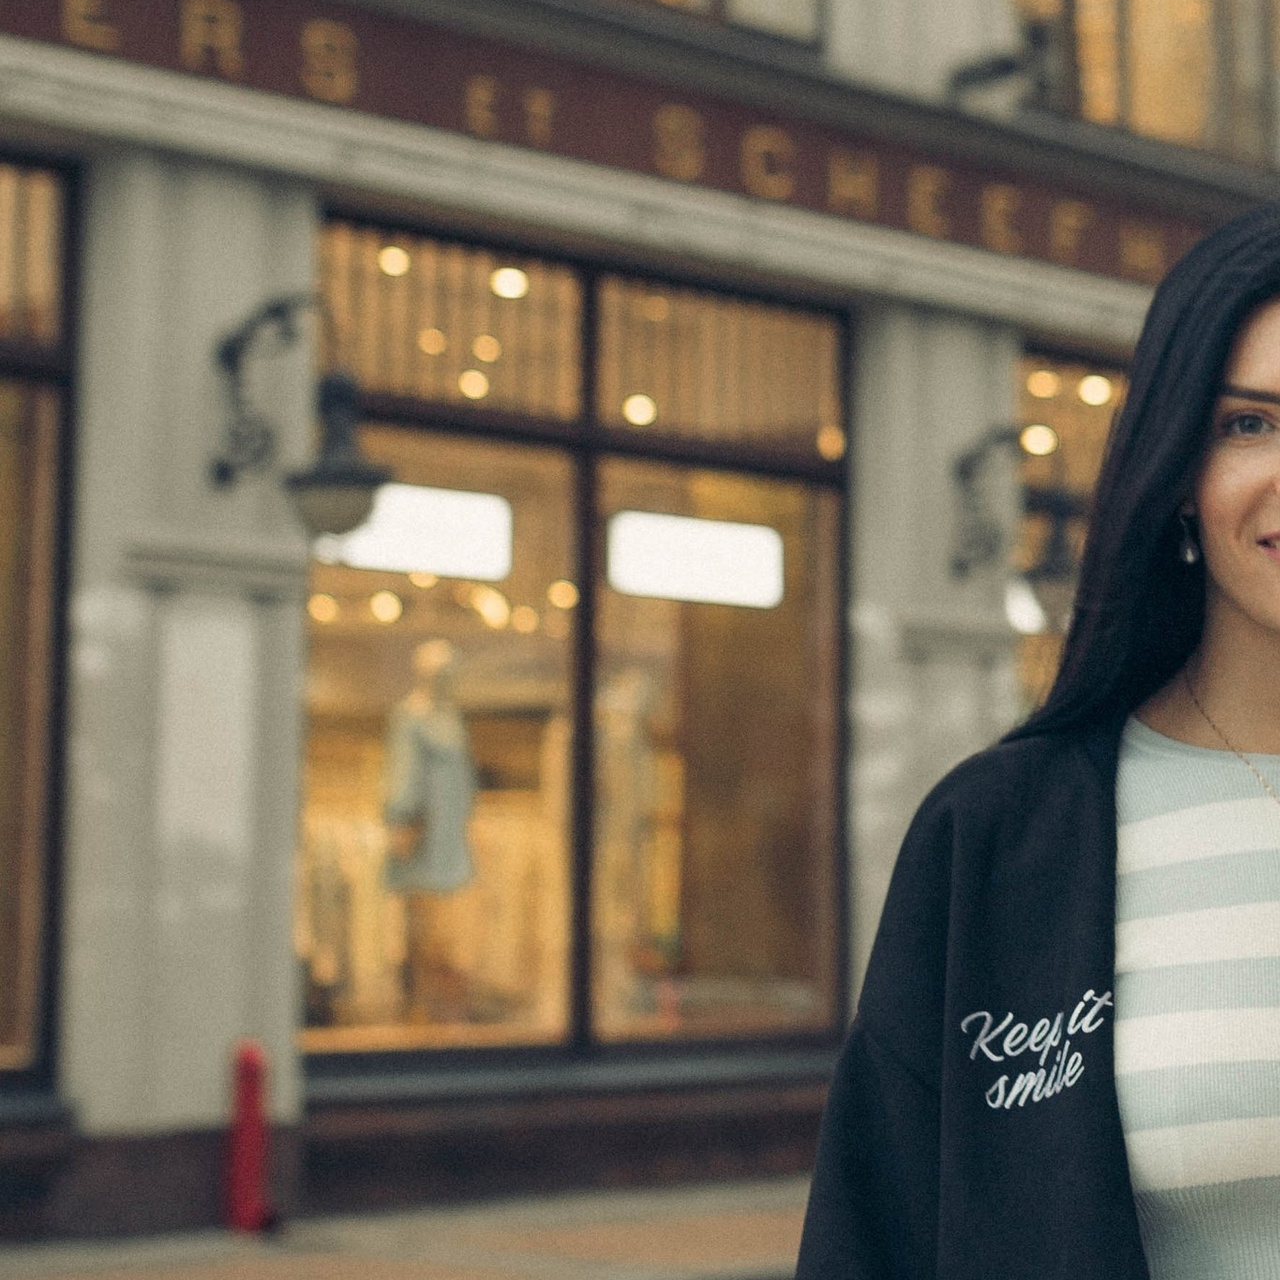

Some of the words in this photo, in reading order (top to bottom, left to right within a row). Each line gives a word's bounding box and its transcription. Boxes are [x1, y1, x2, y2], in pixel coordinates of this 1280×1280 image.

[960, 1010, 1064, 1066] Keep
[1066, 988, 1114, 1034] it
[984, 1040, 1085, 1110] smile
